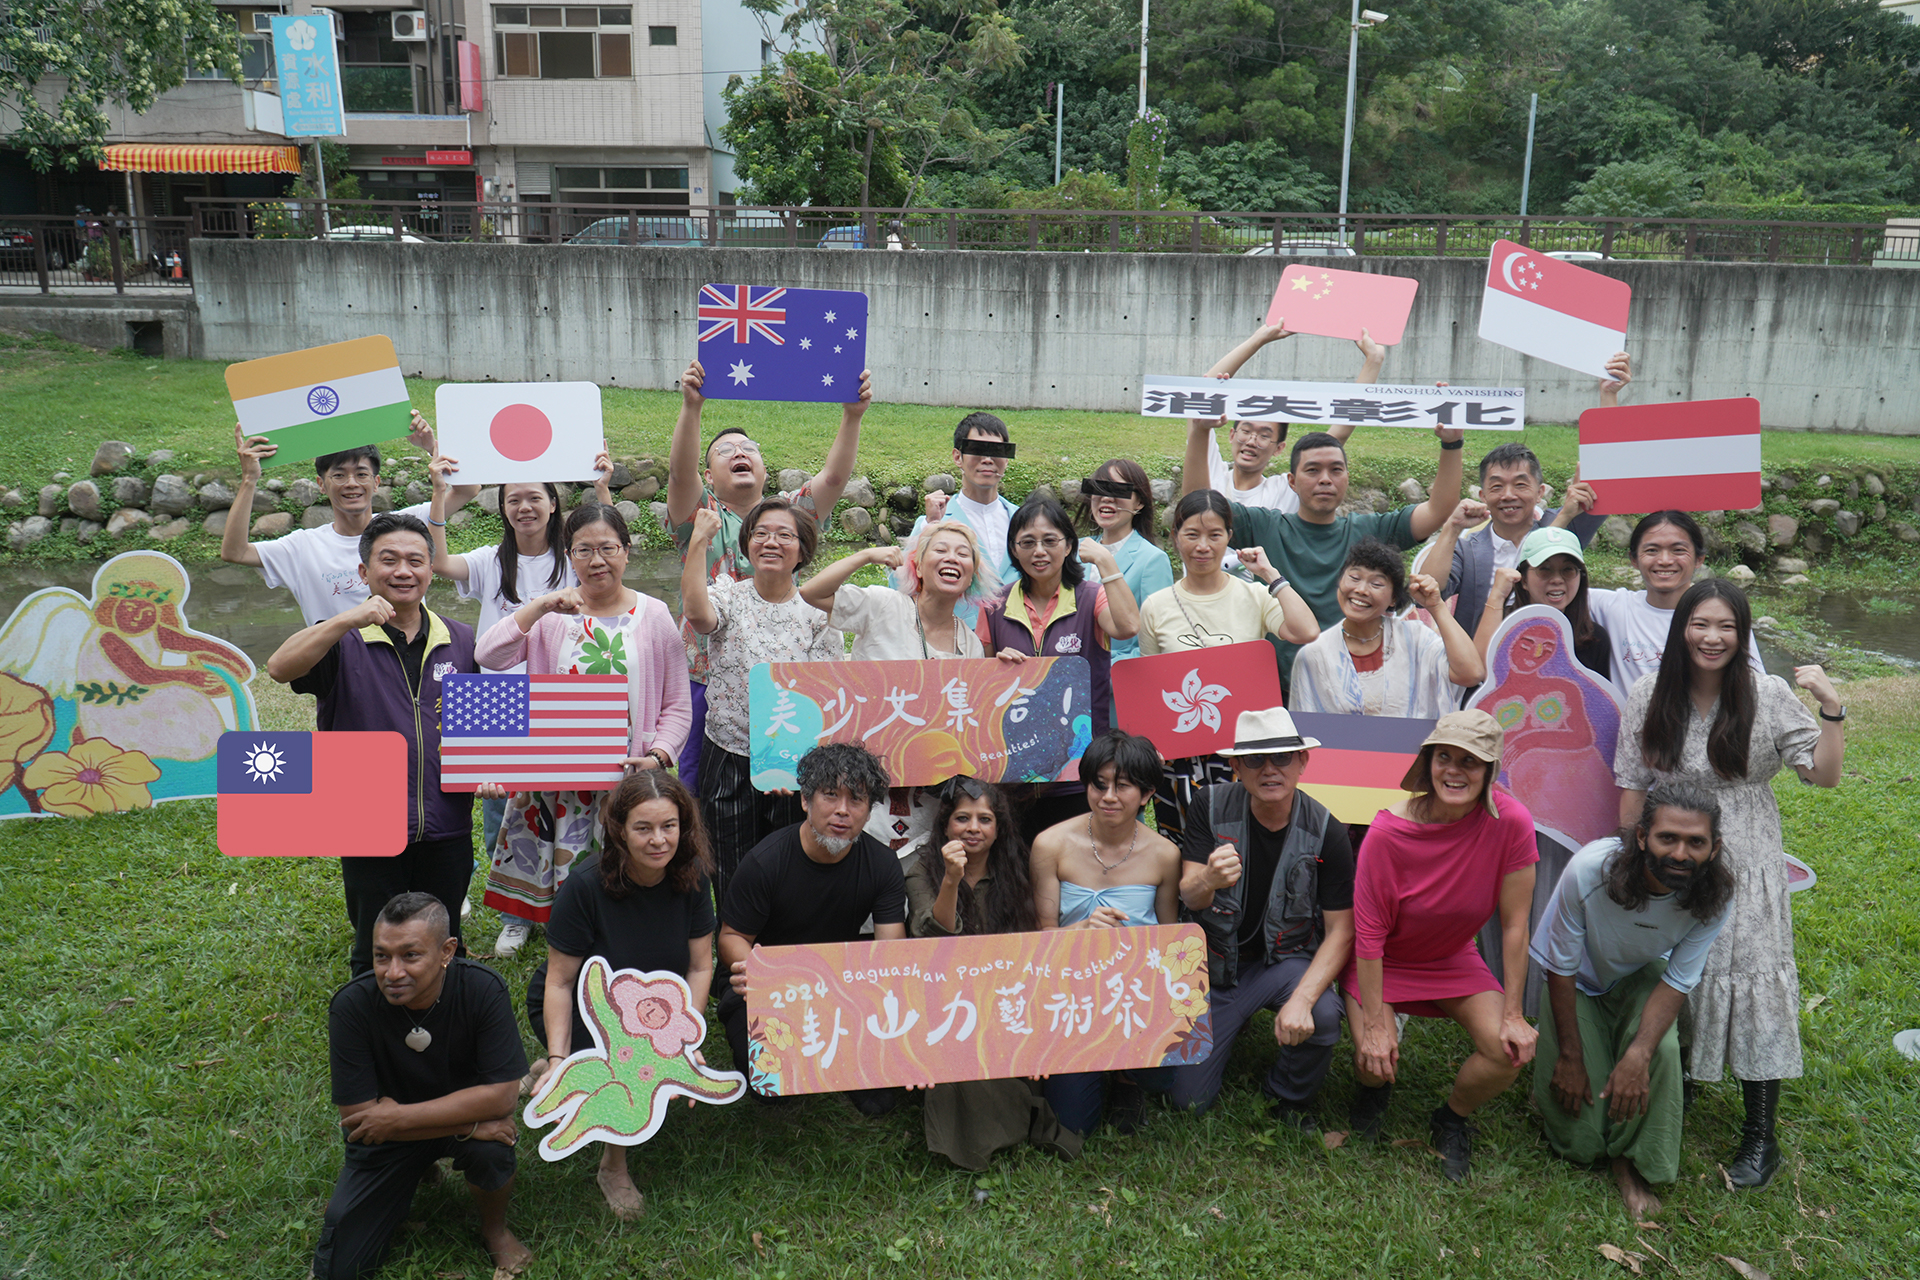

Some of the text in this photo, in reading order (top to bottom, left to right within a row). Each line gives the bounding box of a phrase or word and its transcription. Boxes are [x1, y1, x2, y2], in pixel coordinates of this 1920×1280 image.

[282, 53, 302, 109] 資源處
[302, 52, 332, 108] 水利
[1144, 389, 1516, 426] 消失彰化
[1364, 386, 1524, 398] CHANGHUA VANISHING
[1547, 528, 1563, 543] C
[765, 677, 1073, 740] 美少女集合!
[980, 733, 1040, 762] Beauties!
[842, 941, 1132, 984] Baguashan Power Art Festival
[770, 985, 829, 1009] 2024
[801, 972, 1151, 1070] 卦山力藝術祭
